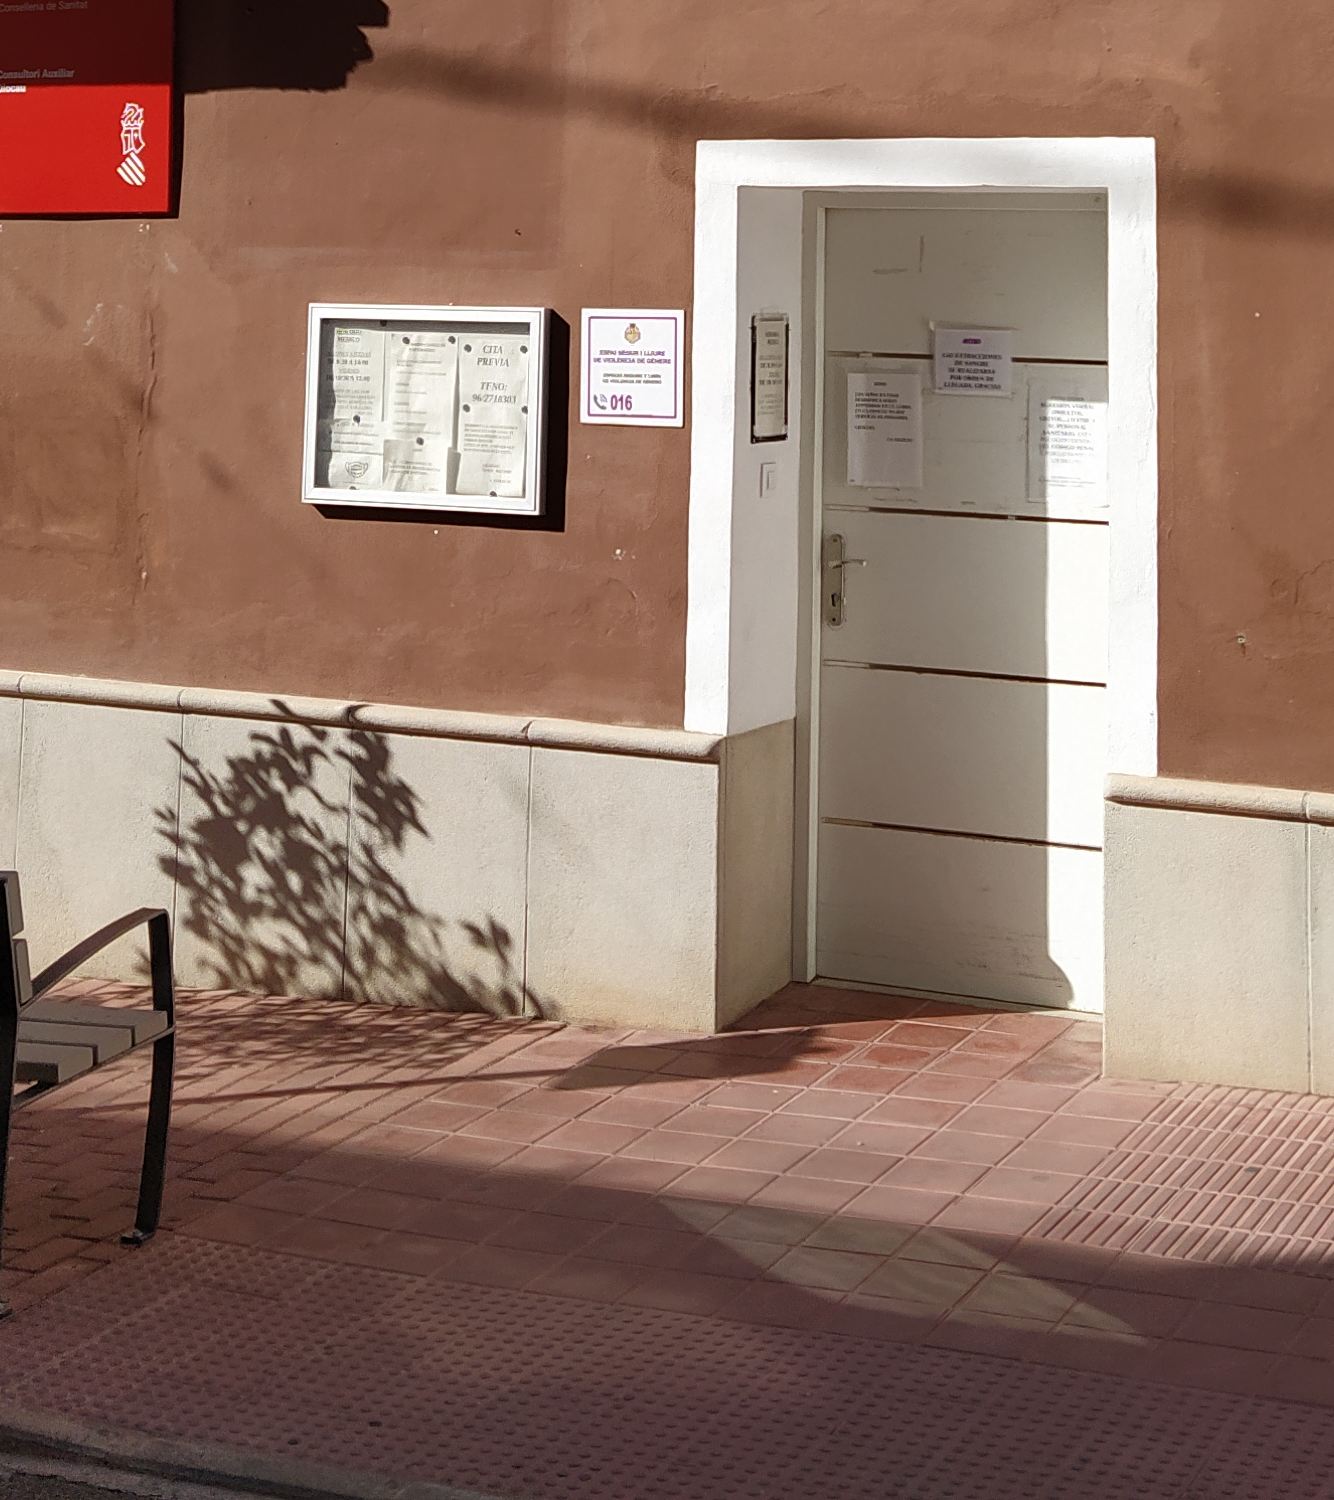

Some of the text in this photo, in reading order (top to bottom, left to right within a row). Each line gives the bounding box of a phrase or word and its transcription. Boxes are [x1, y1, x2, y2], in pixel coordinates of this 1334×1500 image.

[46, 1, 57, 11] de
[58, 0, 88, 11] Sanitat
[42, 68, 75, 78] Auxiliar
[477, 357, 510, 367] PREVIA
[610, 394, 633, 411] 016
